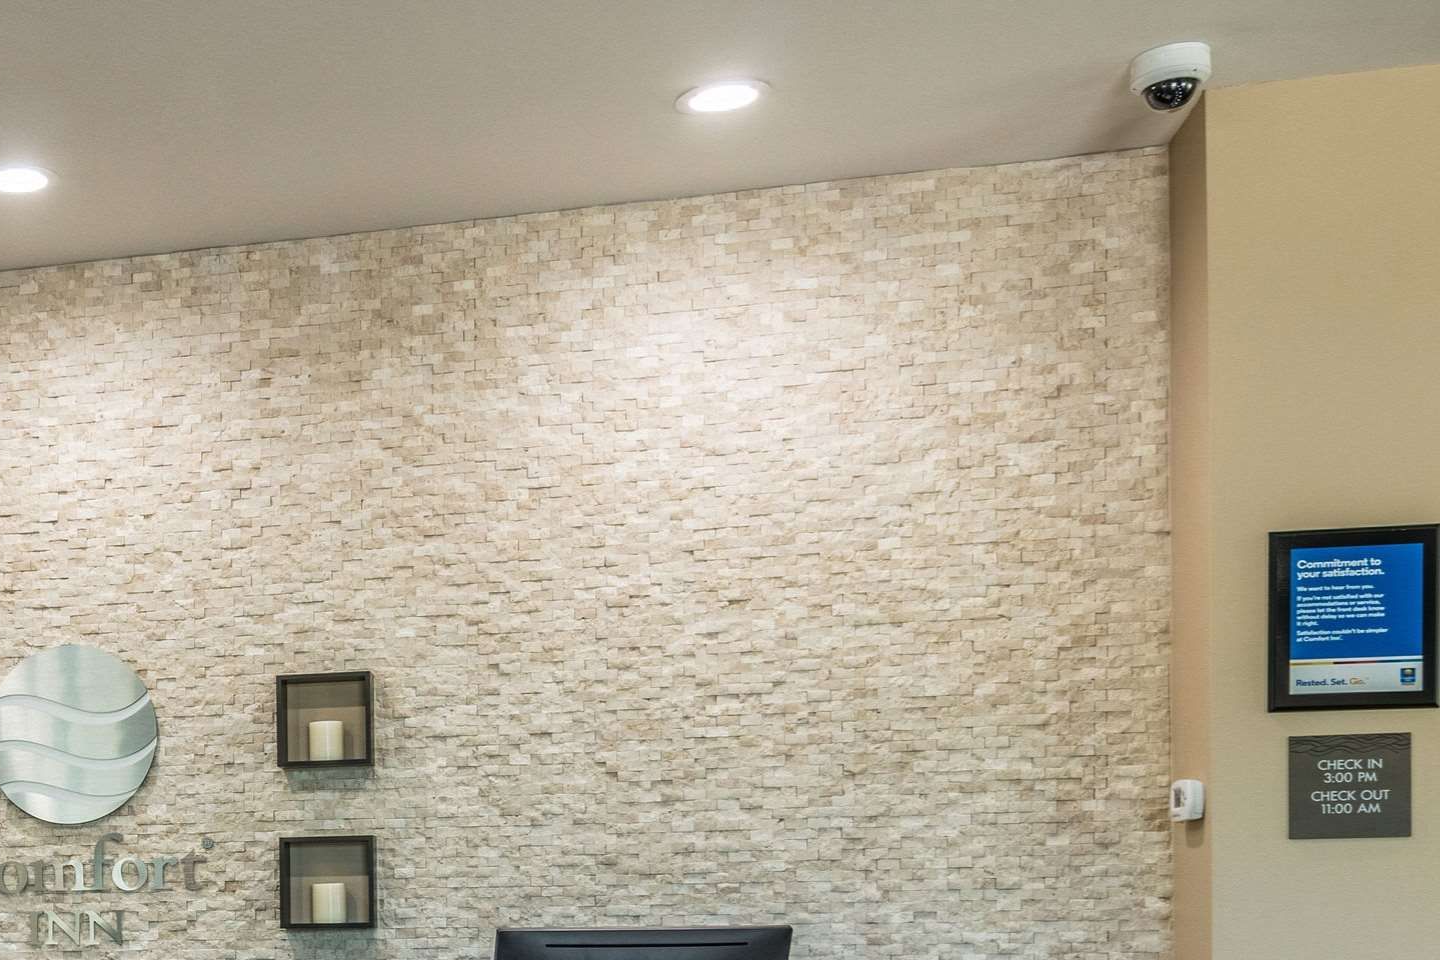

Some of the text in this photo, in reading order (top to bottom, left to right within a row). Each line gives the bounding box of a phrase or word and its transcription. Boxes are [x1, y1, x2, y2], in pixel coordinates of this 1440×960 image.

[1297, 558, 1382, 569] Commitment to
[1296, 567, 1385, 580] your satisfaction.
[1317, 759, 1383, 770] CHECK IN
[1323, 772, 1377, 783] 3:00 PM
[1311, 789, 1392, 801] CHECK OUT
[1321, 803, 1381, 814] 11:00 AM
[31, 909, 124, 947] INN
